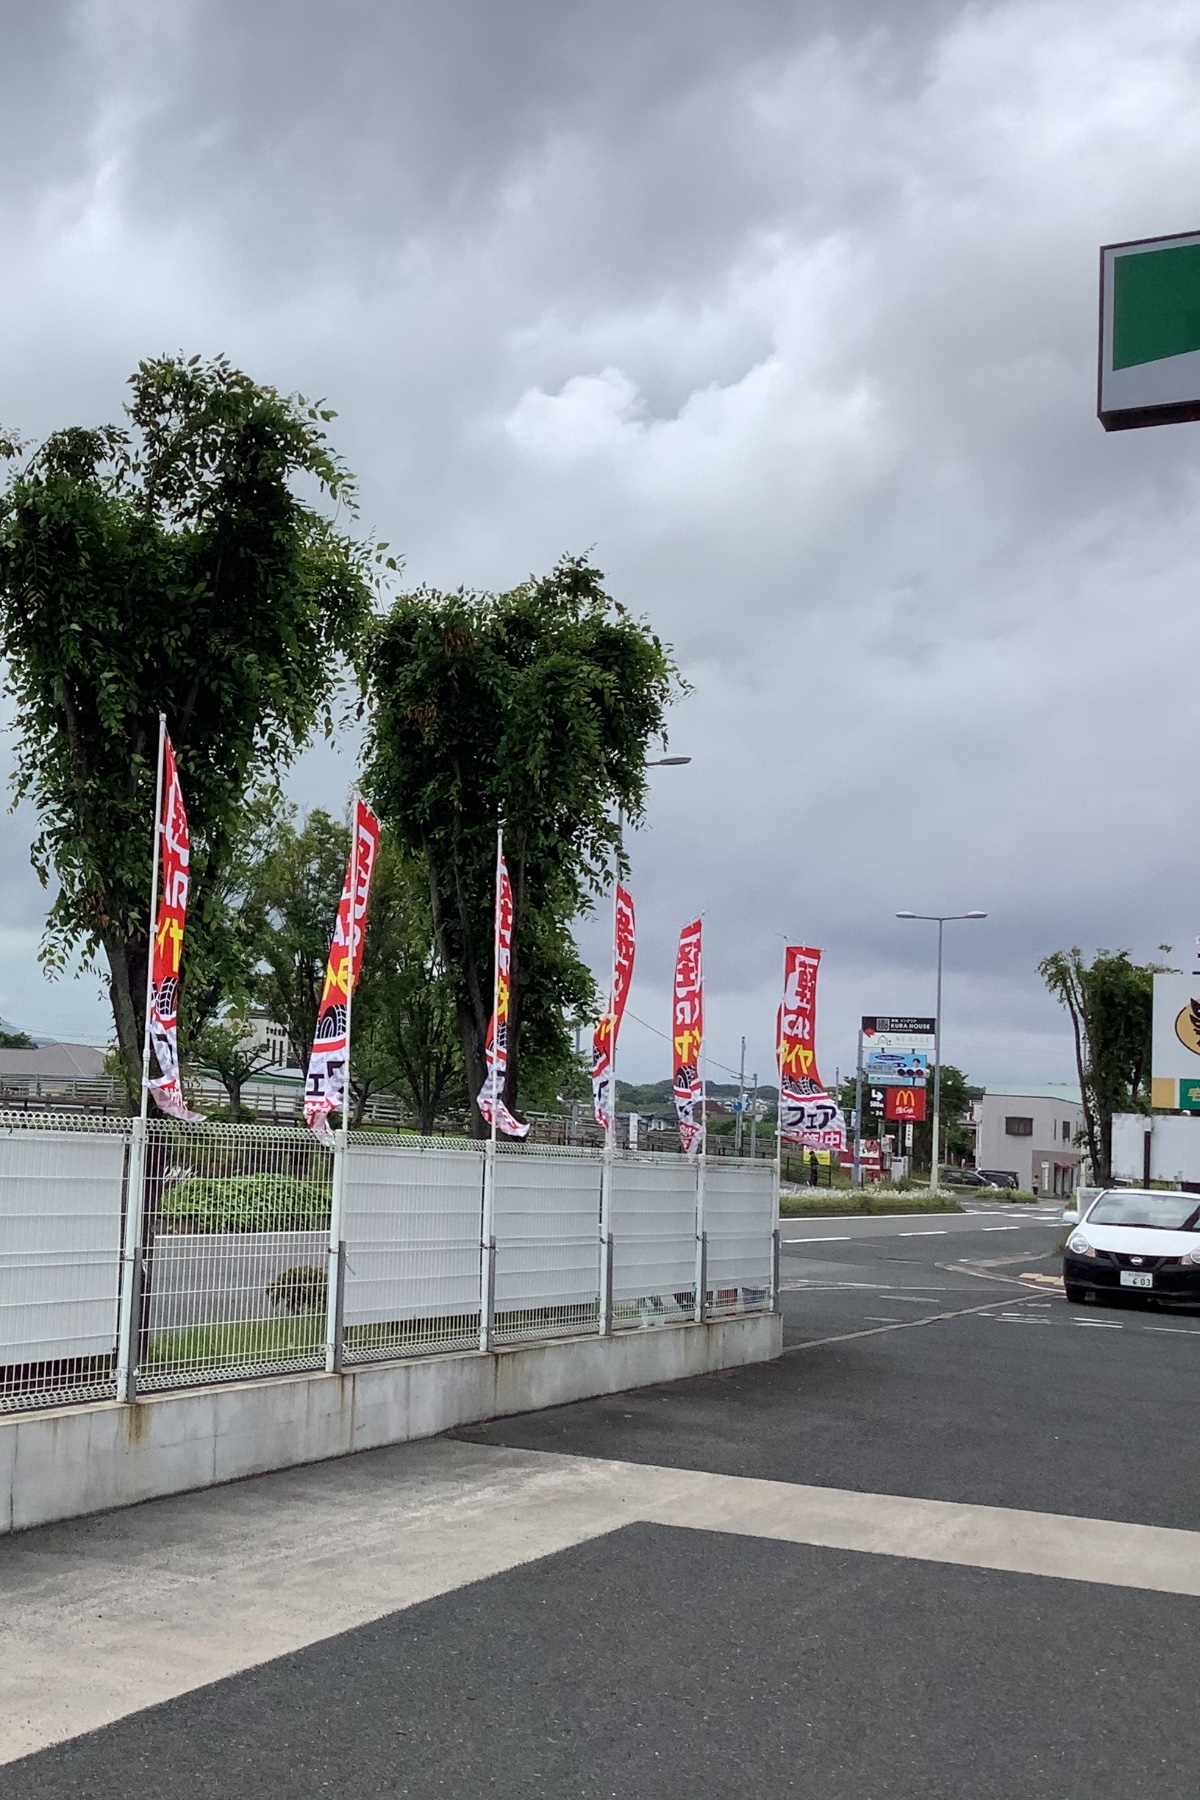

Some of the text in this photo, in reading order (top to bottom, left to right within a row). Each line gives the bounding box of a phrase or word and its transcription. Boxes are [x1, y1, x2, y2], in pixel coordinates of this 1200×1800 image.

[783, 1014, 811, 1040] CAR
[787, 1105, 837, 1129] フェア
